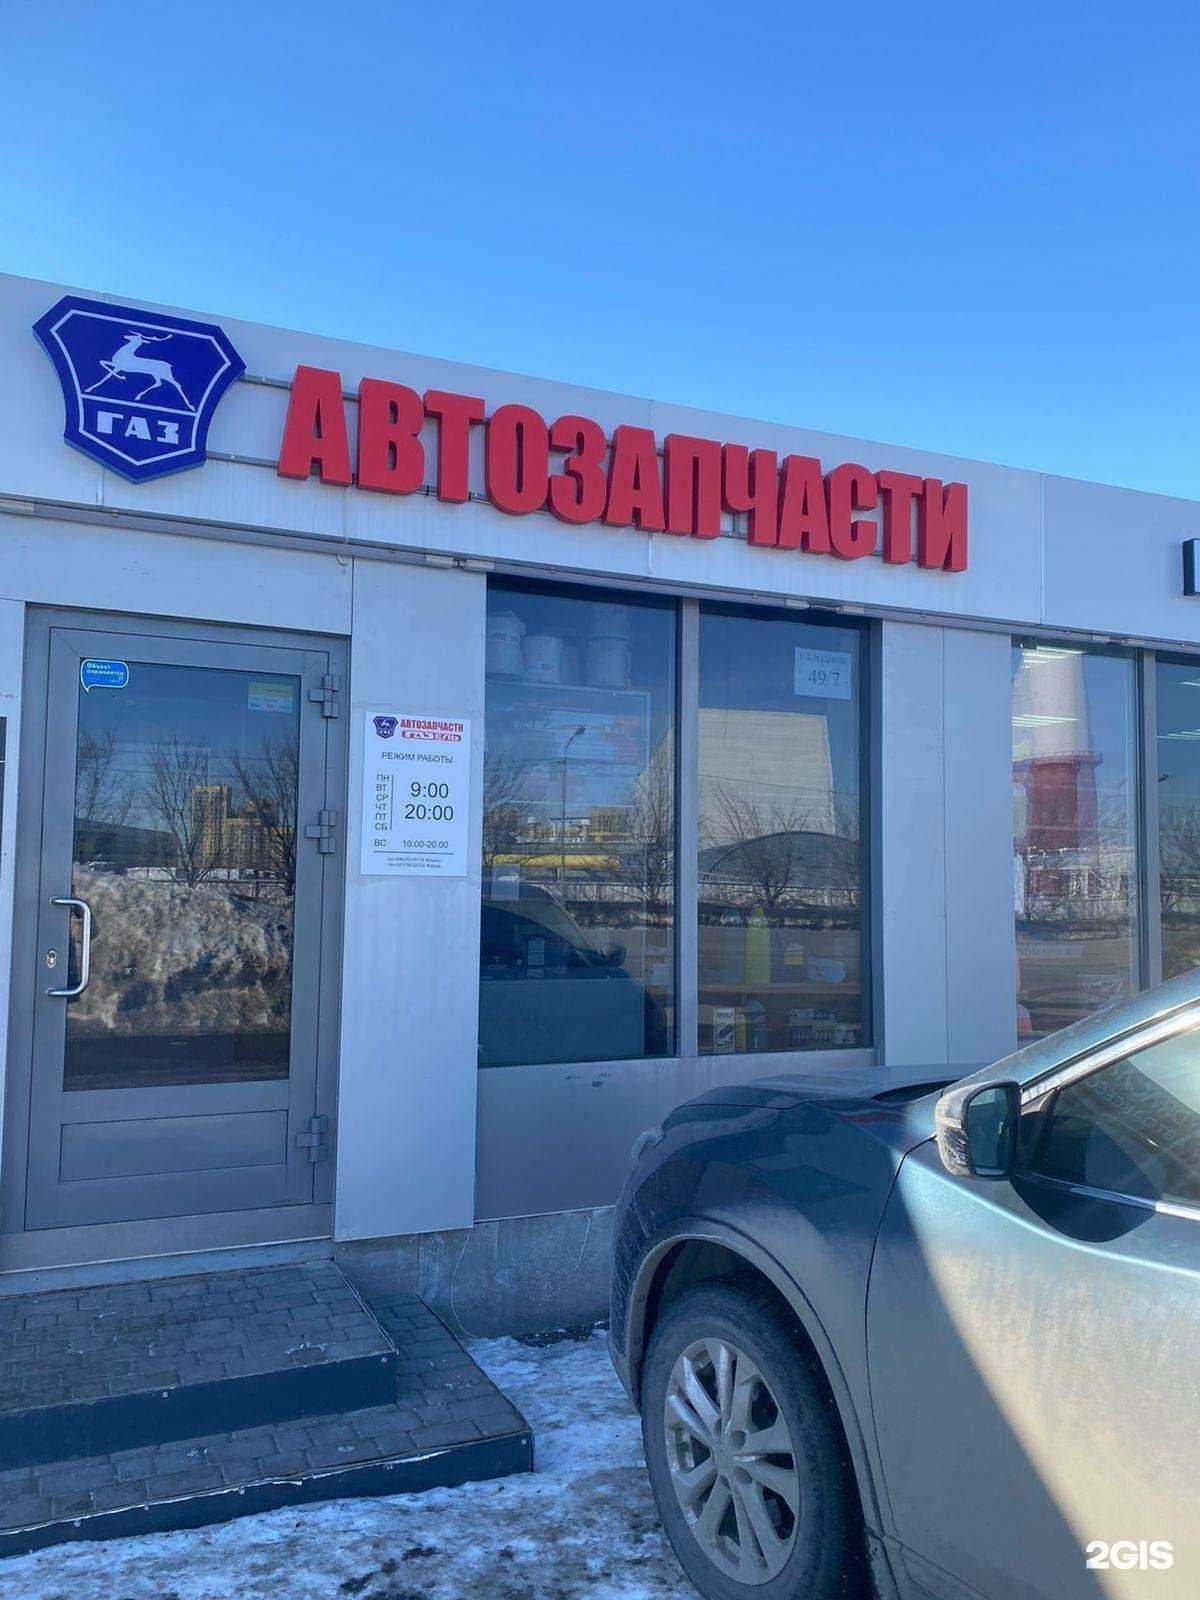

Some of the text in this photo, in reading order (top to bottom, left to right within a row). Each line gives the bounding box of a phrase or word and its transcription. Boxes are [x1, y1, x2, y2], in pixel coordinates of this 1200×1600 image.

[96, 410, 180, 444] ГАЗ
[278, 364, 968, 573] АВТОЗАПЧАСТИ
[808, 669, 840, 687] 49/7
[400, 718, 464, 732] АВТОЗАПЧАСТИ
[381, 751, 453, 764] РЕЖИМ РАБОТЫ
[376, 774, 390, 782] ПН
[376, 784, 387, 792] ВТ
[411, 781, 449, 798] 9:00
[376, 793, 389, 802] СР
[375, 803, 387, 811] ЧТ
[404, 803, 454, 821] 20:00
[375, 813, 387, 821] ПТ
[374, 822, 388, 831] СБ
